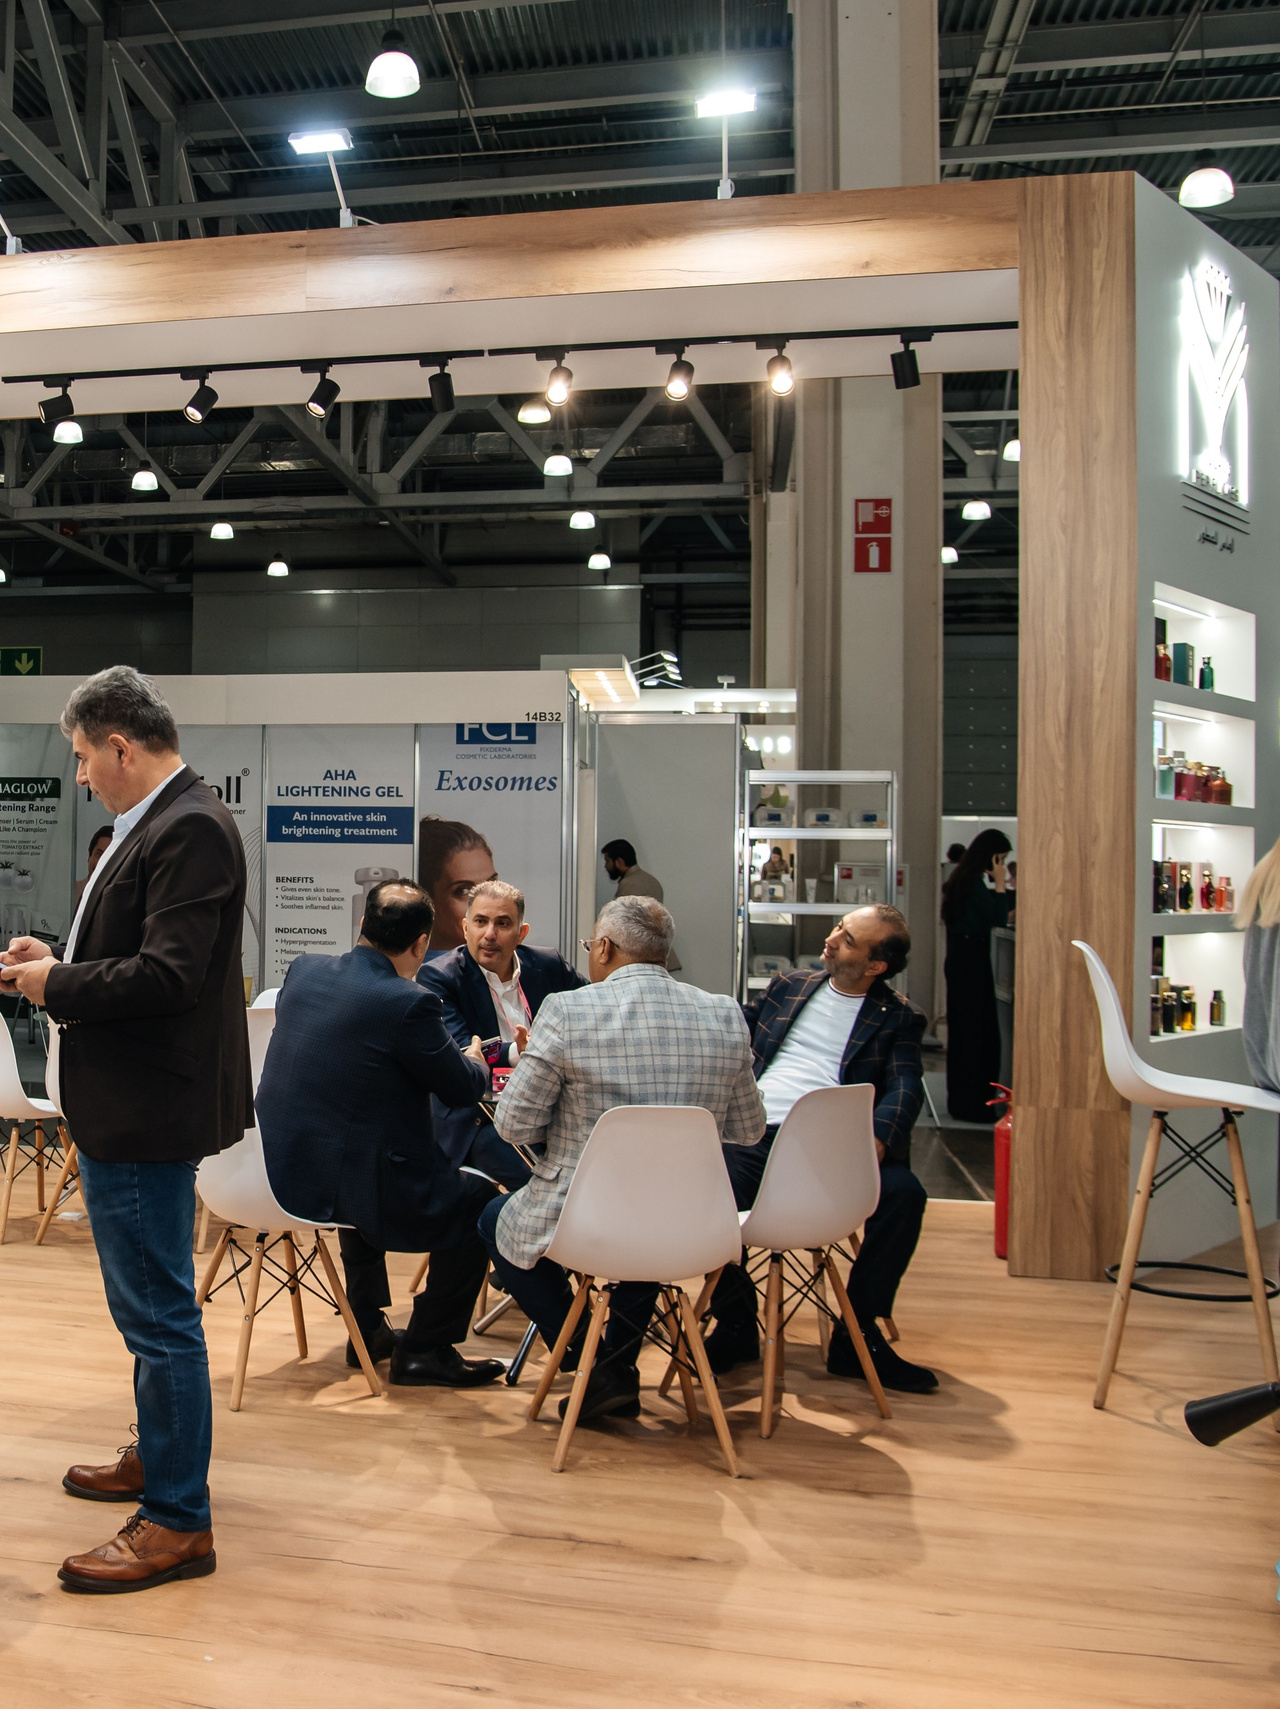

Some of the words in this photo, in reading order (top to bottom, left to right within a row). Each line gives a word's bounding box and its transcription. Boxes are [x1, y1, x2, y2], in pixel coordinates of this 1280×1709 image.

[525, 711, 562, 722] 14B32
[322, 769, 357, 781] AHA
[434, 769, 558, 792] Exosomes
[276, 785, 371, 798] LIGHTENING
[375, 785, 404, 798] GEL
[28, 803, 57, 814] Range
[292, 811, 308, 822] An
[310, 811, 363, 822] innovative
[365, 812, 387, 822] skin
[17, 826, 48, 834] Champion
[281, 825, 342, 838] brightening
[343, 826, 398, 837] treatment
[275, 876, 314, 884] BENEFITS
[274, 927, 327, 935] INDICATIONS
[280, 938, 337, 947] Hyperpigmentation
